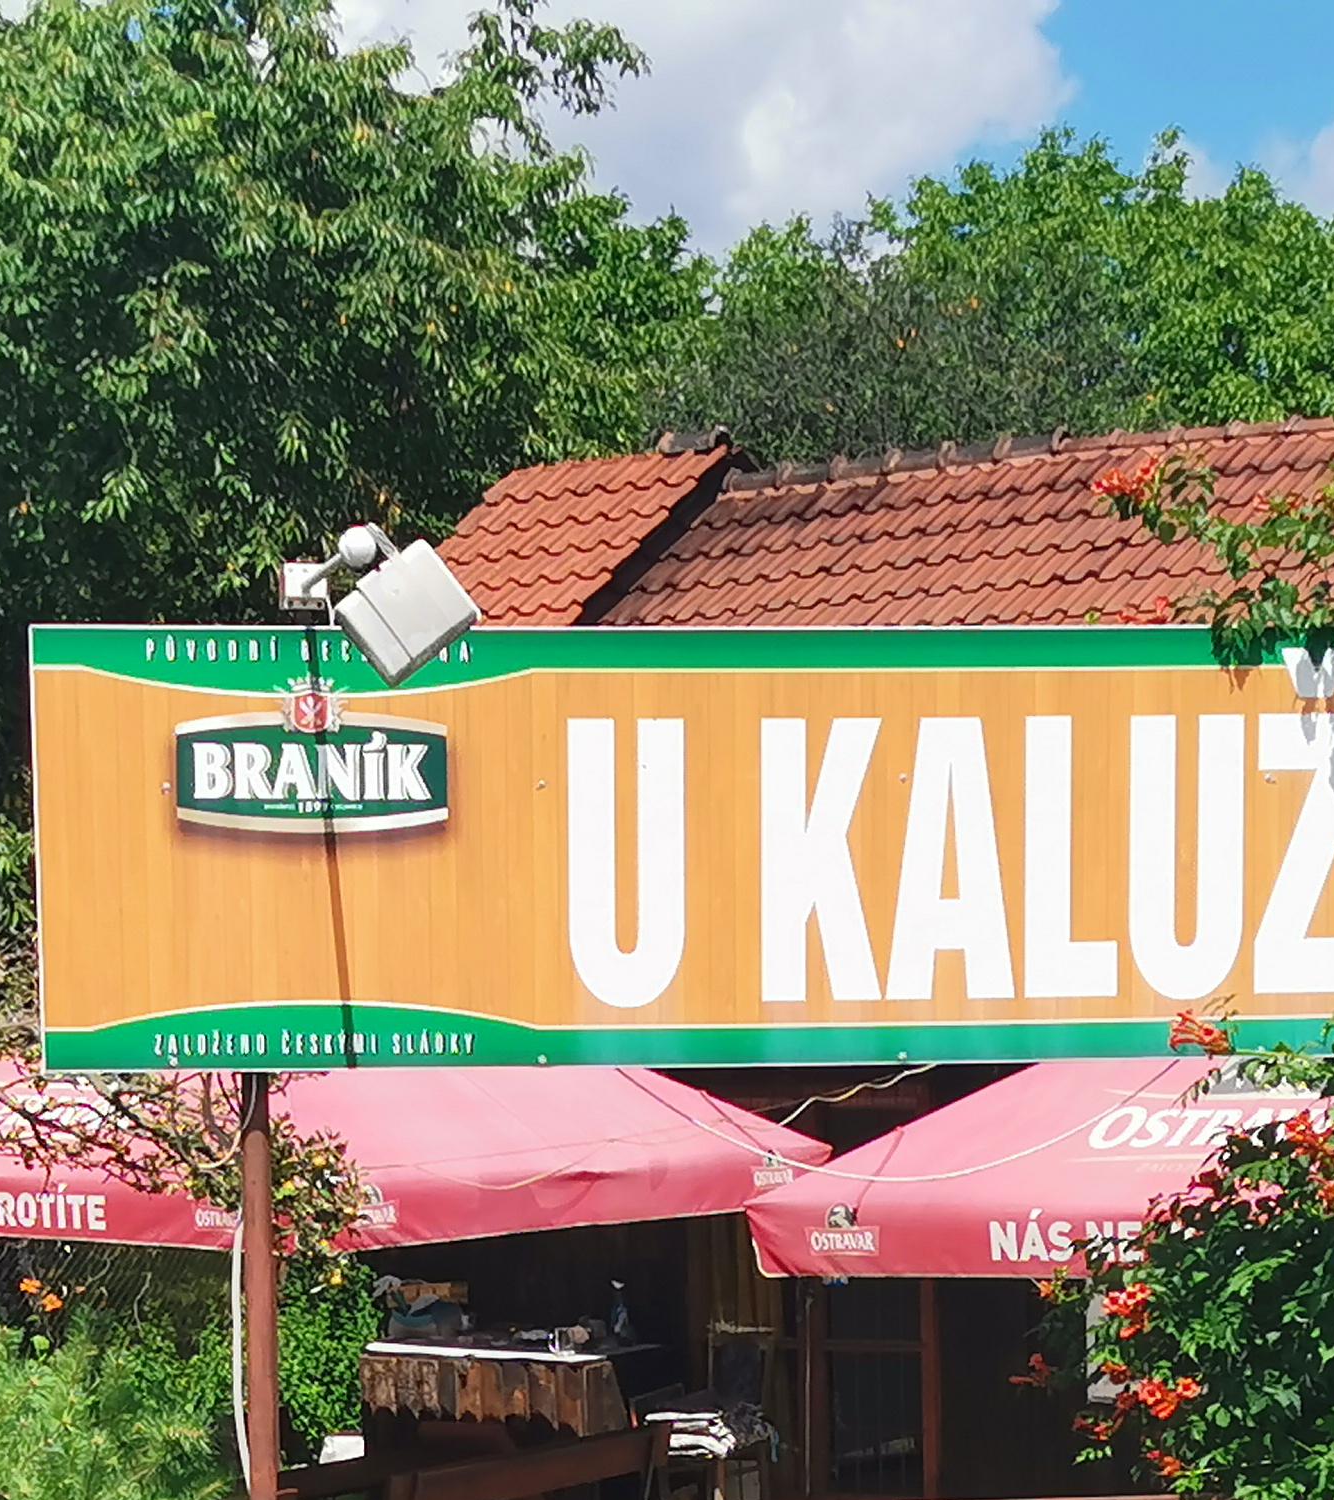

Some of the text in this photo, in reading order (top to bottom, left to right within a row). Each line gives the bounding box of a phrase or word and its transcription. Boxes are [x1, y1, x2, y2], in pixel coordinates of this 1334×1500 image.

[145, 633, 279, 663] PŮVODNÍ
[192, 731, 434, 801] BRANÍK
[566, 716, 686, 1008] U
[153, 1027, 475, 1057] ZALOŽENO ČESKÝMI SLÁDKY
[810, 1231, 876, 1252] OSTRAVAR
[988, 1207, 1073, 1263] NÁS
